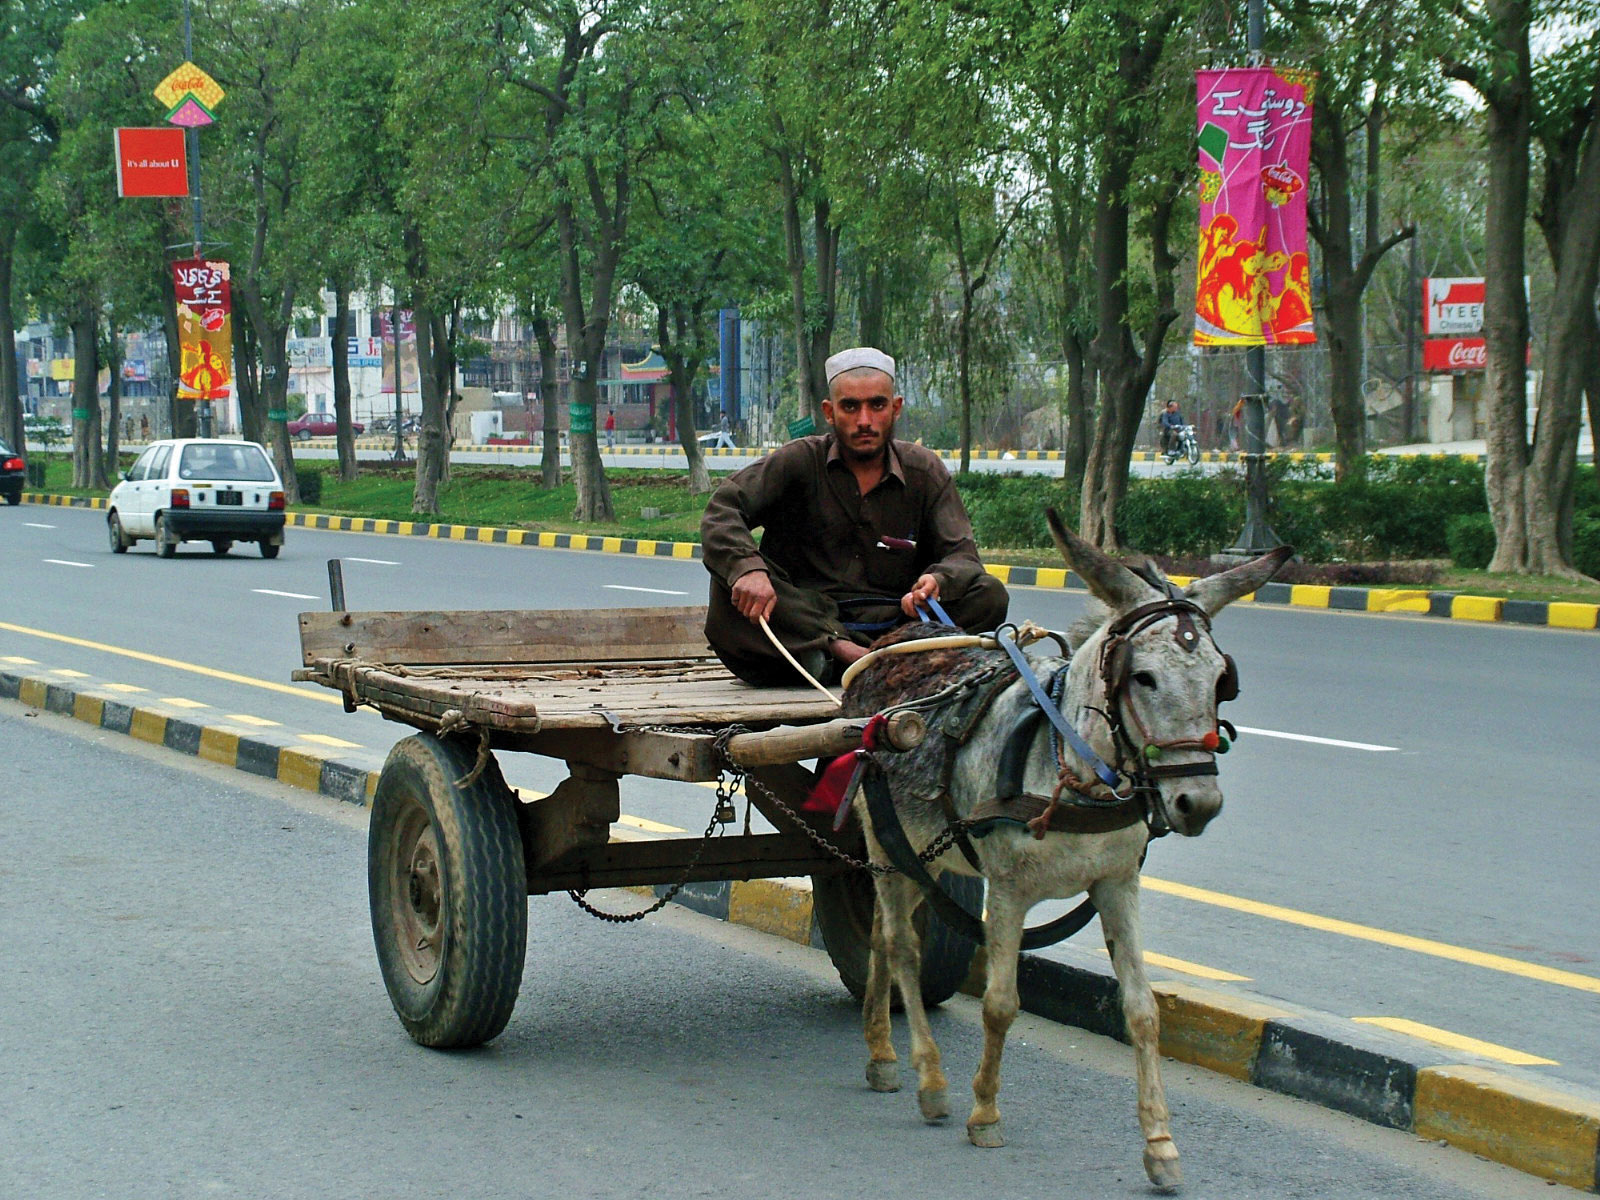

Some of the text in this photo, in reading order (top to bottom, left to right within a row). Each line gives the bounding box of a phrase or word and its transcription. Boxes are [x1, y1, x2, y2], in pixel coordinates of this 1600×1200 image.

[1212, 89, 1306, 117] دوستی کے
[1229, 119, 1275, 150] رنگ
[149, 159, 171, 168] about
